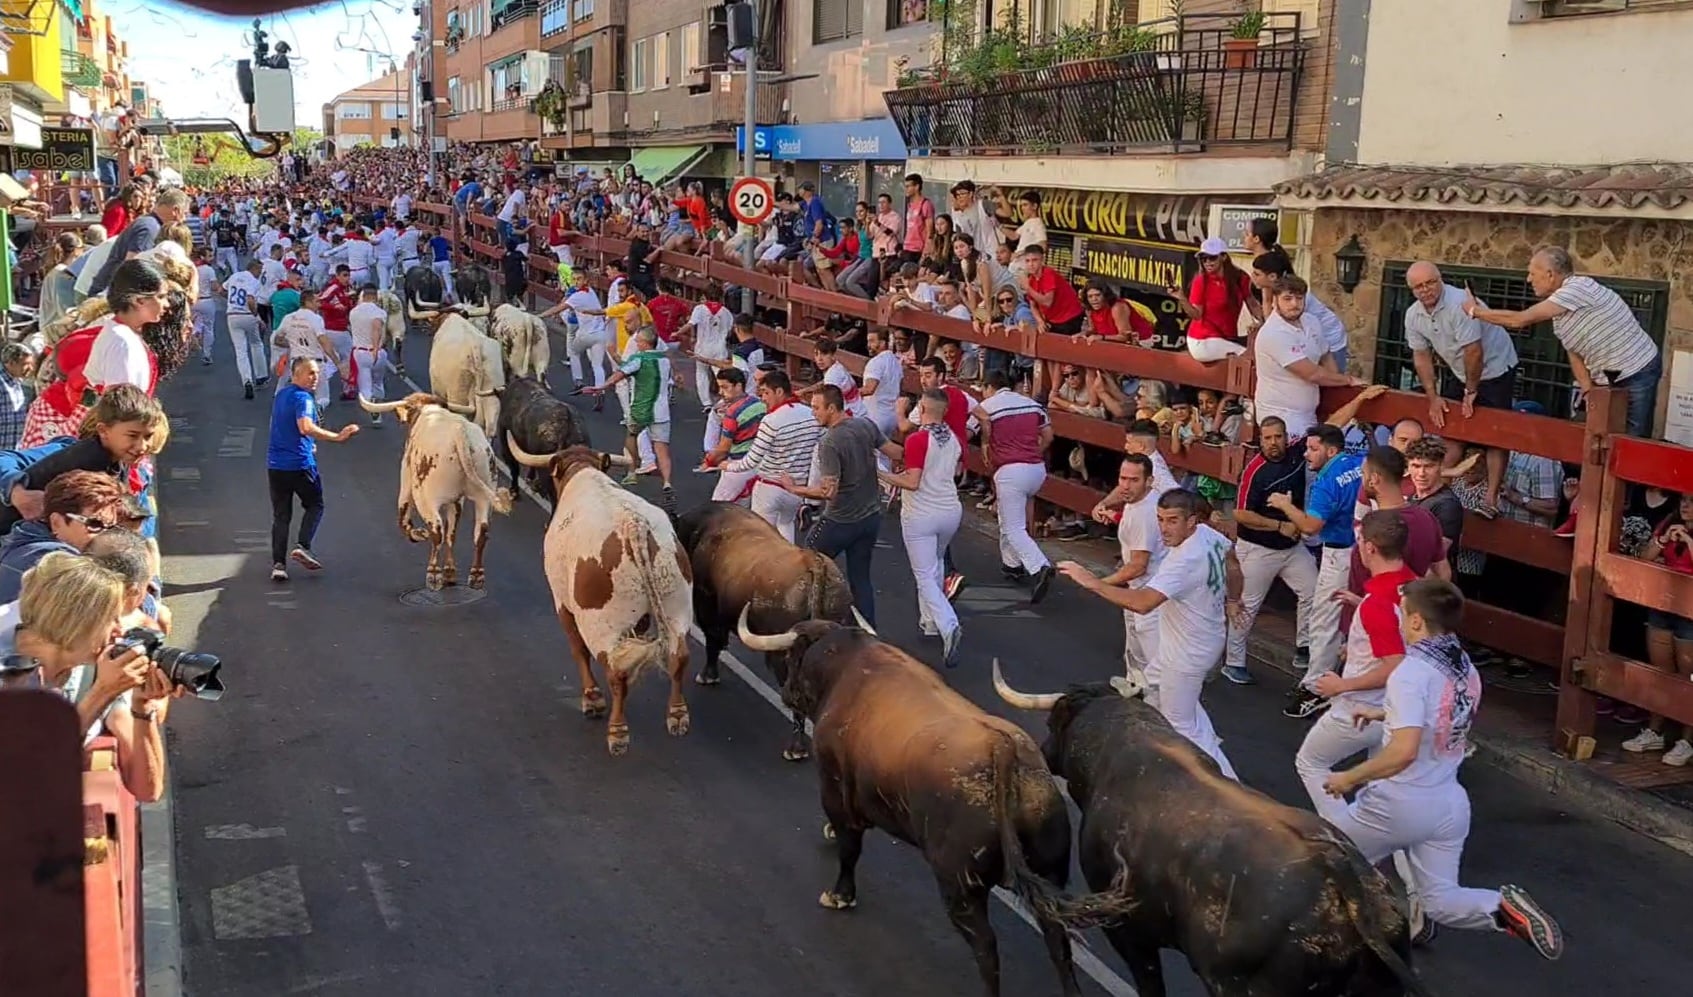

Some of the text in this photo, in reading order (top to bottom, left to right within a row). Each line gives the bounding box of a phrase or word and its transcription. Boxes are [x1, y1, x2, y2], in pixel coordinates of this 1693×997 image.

[41, 130, 88, 142] STERIA
[740, 193, 765, 209] 20
[1007, 188, 1215, 244] COPRO ORO Y PLA
[1087, 250, 1137, 283] TASACIÓN
[230, 286, 246, 306] 28
